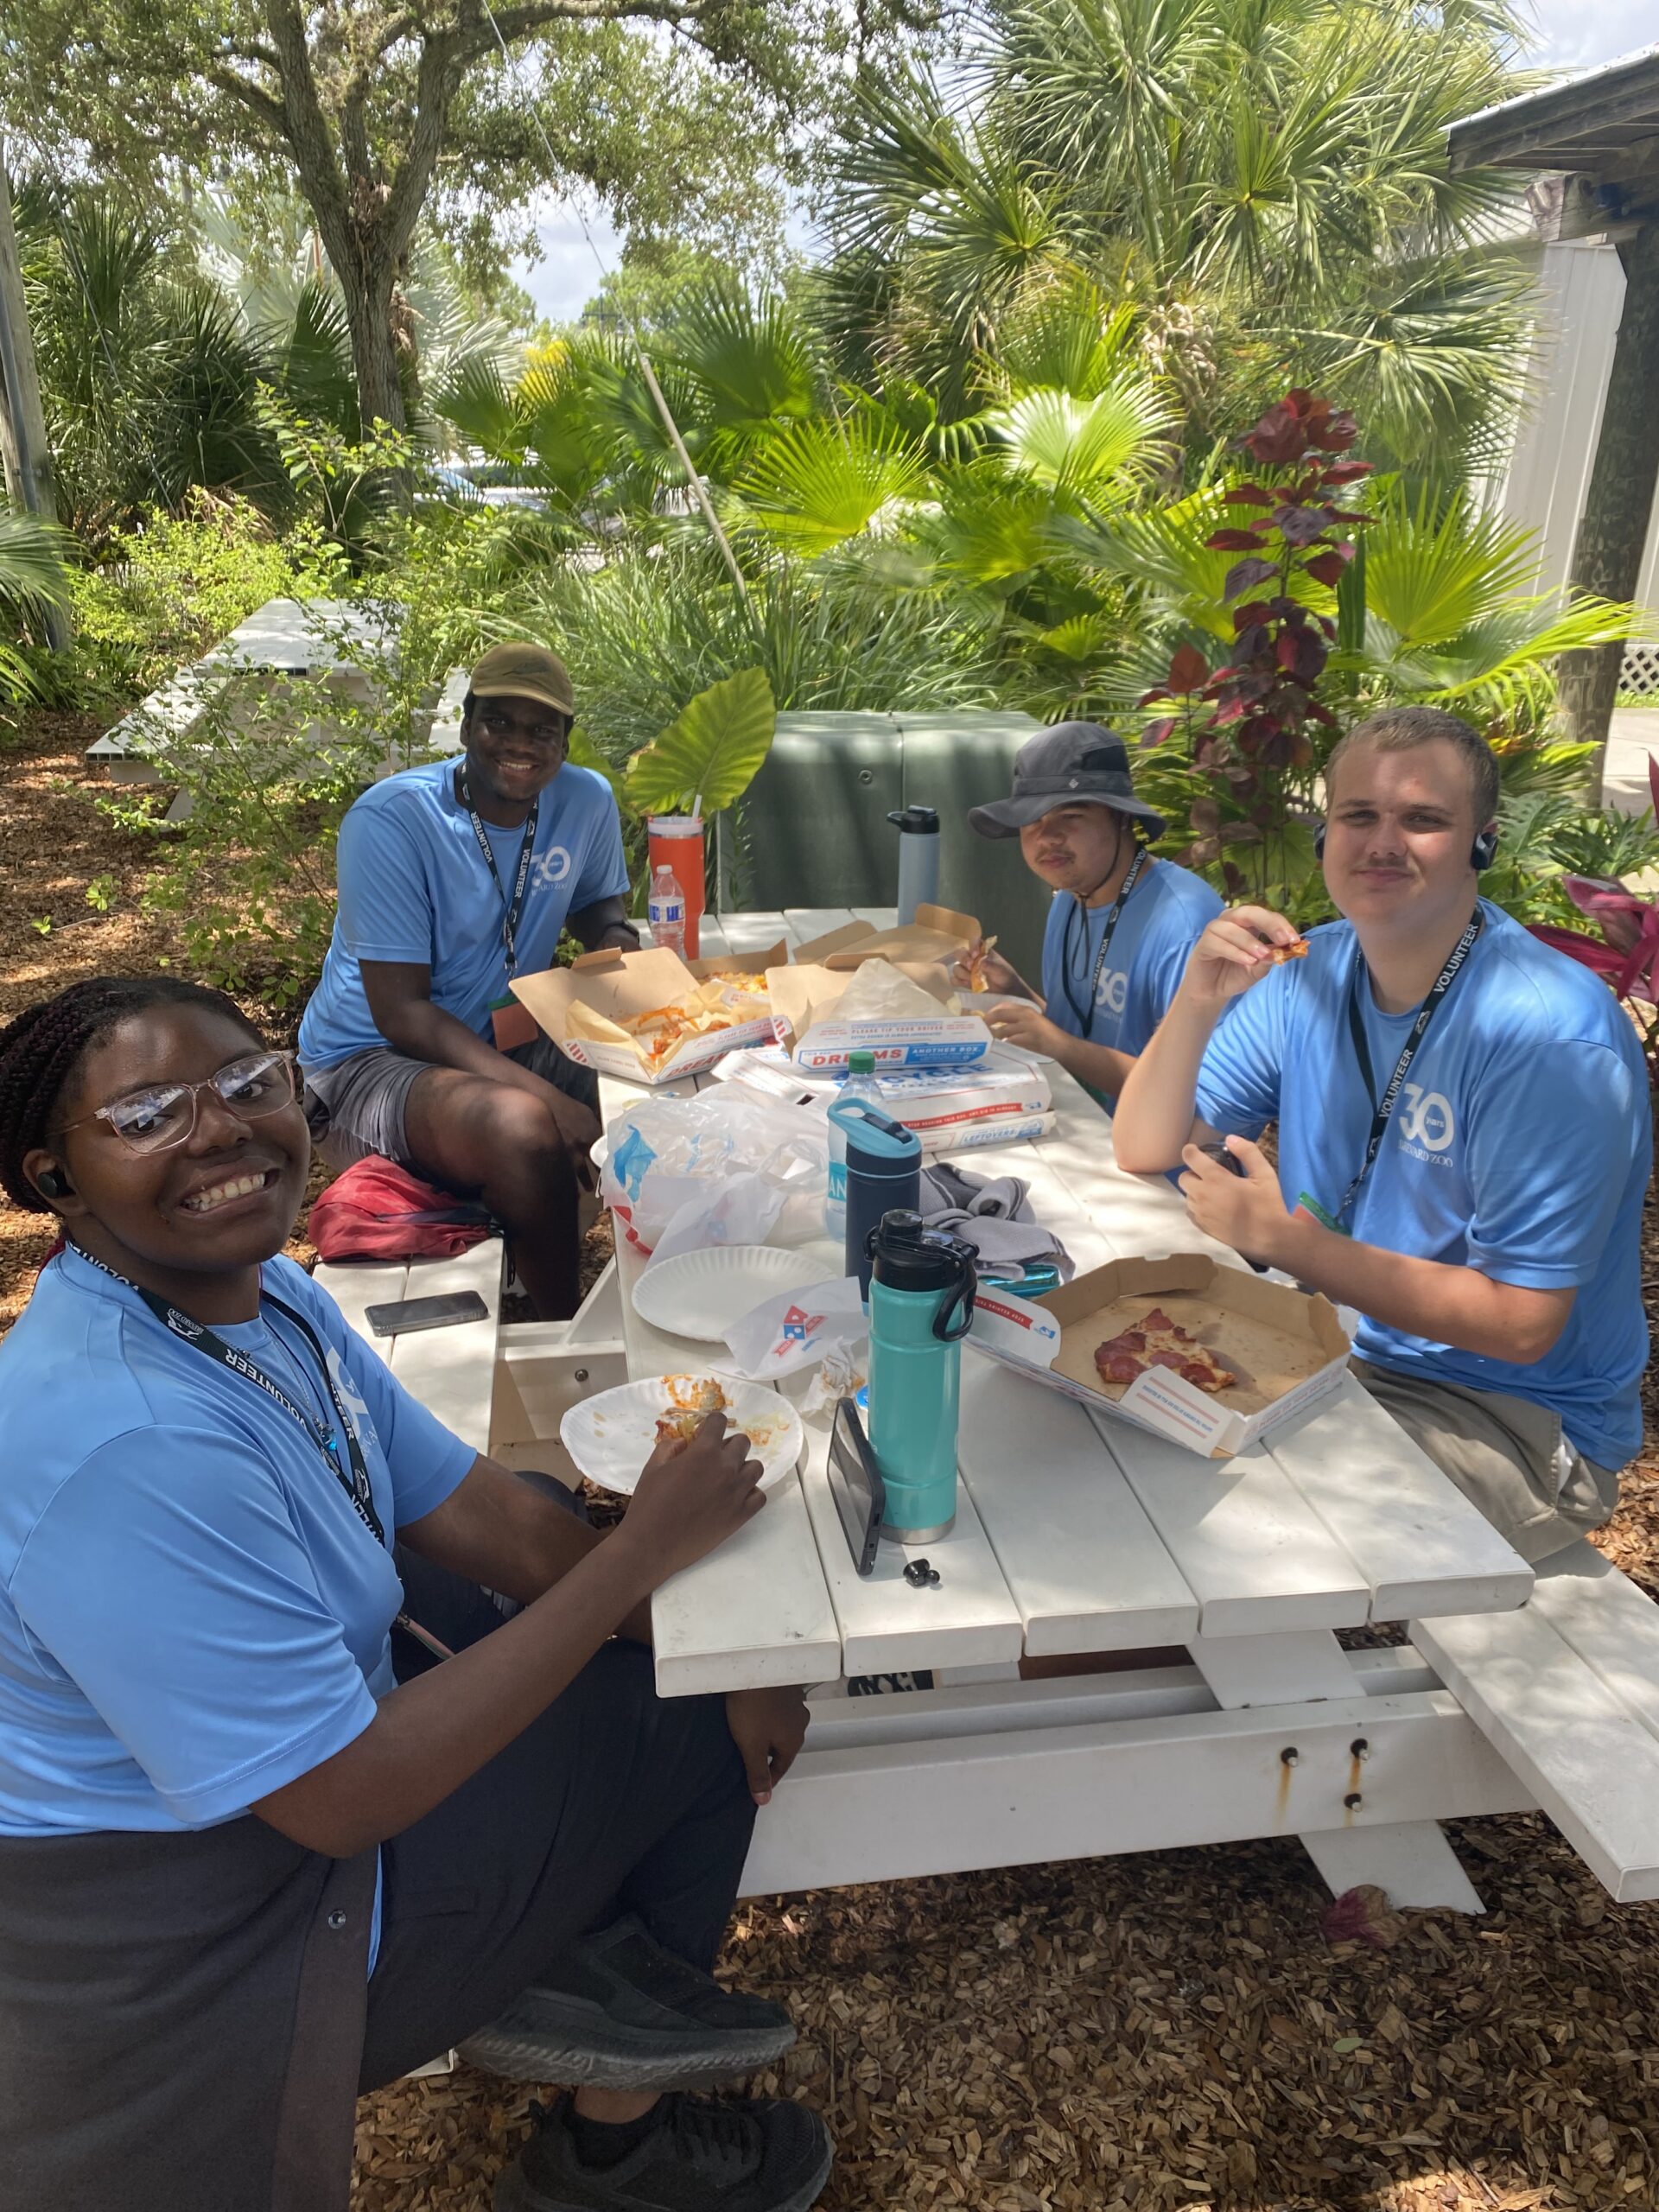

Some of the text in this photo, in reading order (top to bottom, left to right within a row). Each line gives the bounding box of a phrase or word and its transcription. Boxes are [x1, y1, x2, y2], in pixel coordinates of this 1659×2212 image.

[470, 811, 493, 863] VOLUNTEER
[514, 849, 531, 899] VOLUNTEER
[1091, 938, 1109, 991] VOLUNTEER
[1433, 923, 1478, 995] VOLUNTEER
[1095, 967, 1128, 1014] 30
[812, 1049, 903, 1065] DREMS
[1378, 1048, 1414, 1119] VOLUNTEER
[1399, 1083, 1455, 1152] 30
[1430, 1154, 1453, 1168] ZOO
[168, 1307, 182, 1320] ZOO
[225, 1348, 308, 1430] VOLUNTEER
